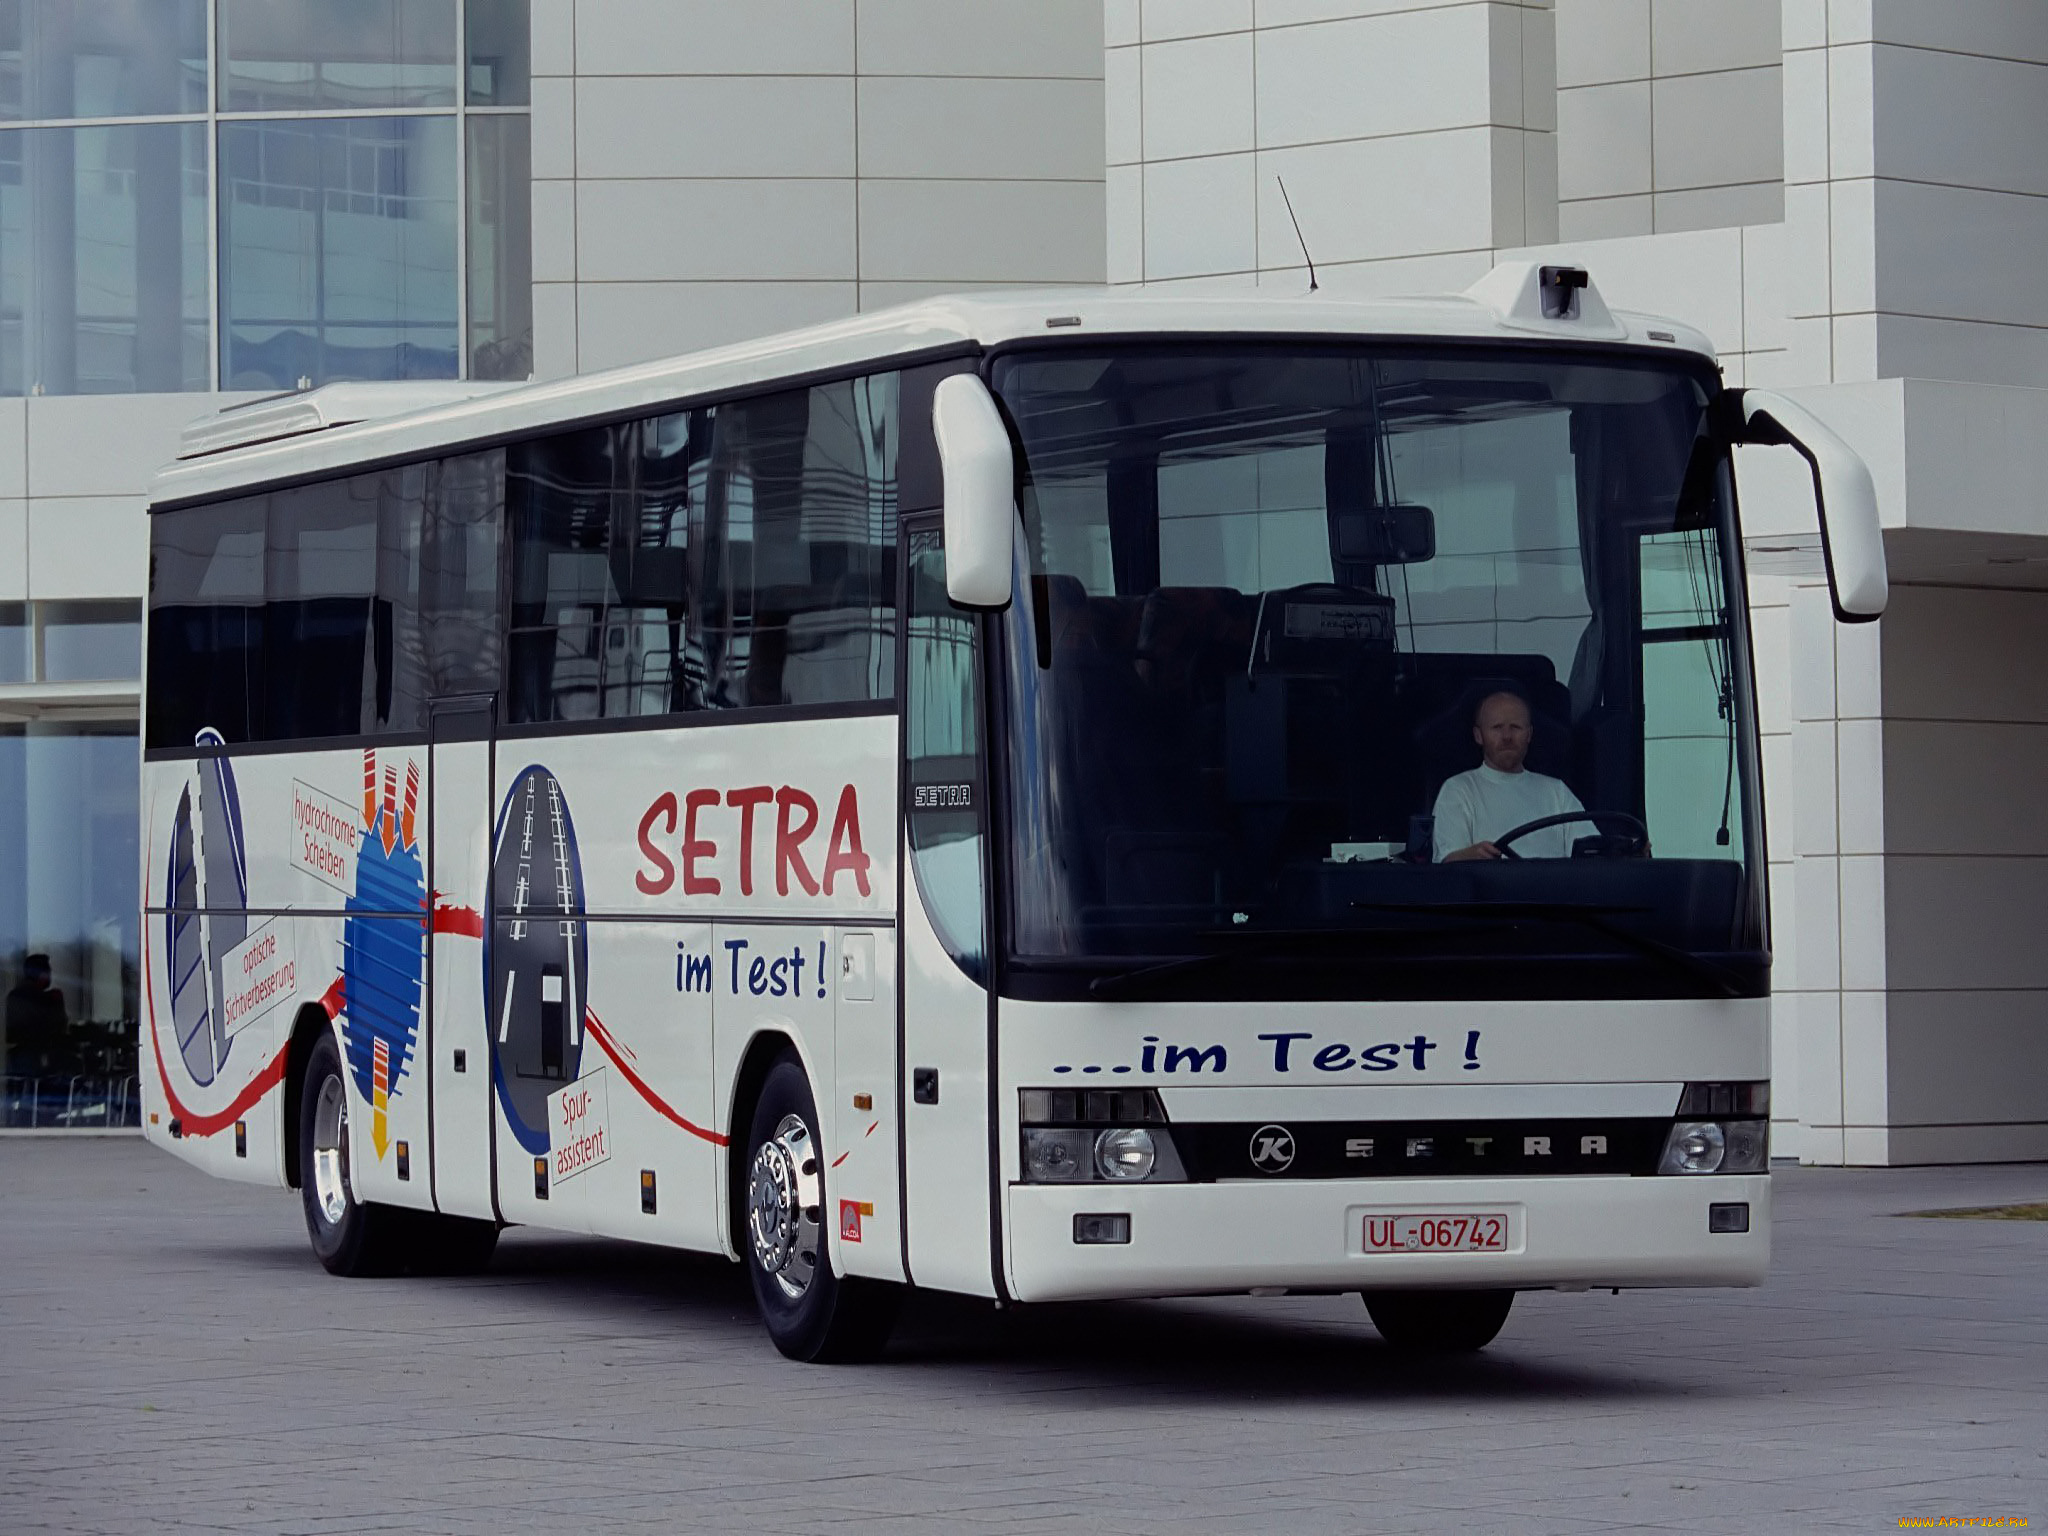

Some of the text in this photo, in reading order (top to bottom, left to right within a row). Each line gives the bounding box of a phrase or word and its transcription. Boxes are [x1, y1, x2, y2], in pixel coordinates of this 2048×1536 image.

[294, 788, 356, 848] hydrochrome
[915, 784, 971, 807] SETRA
[303, 832, 345, 880] Scheiben
[636, 784, 871, 896] SETRA
[243, 932, 276, 978] optische
[676, 941, 712, 994] im
[225, 960, 295, 1026] Sichtverbesserung
[562, 1089, 592, 1132] Spur-
[557, 1124, 605, 1175] assistent
[1369, 1219, 1501, 1248] UL-06742
